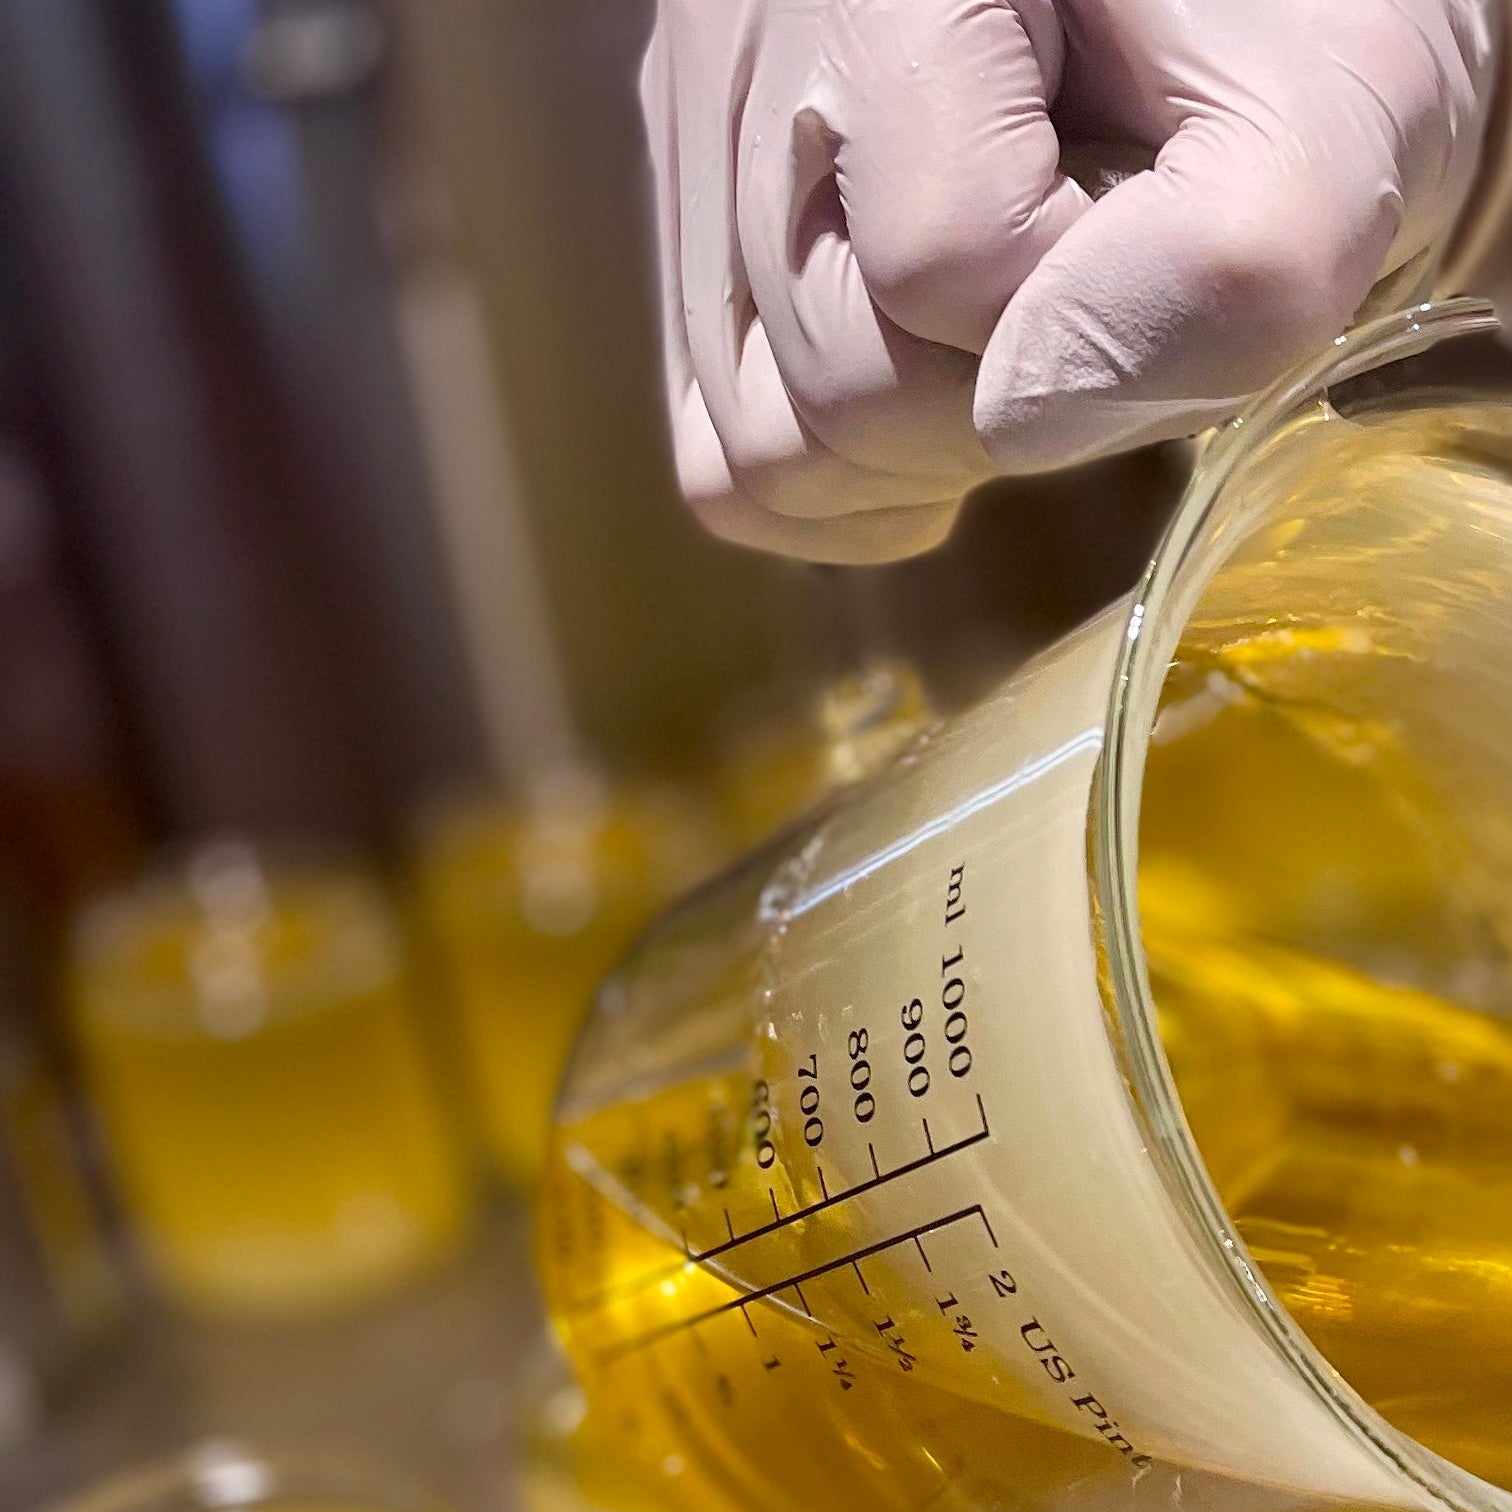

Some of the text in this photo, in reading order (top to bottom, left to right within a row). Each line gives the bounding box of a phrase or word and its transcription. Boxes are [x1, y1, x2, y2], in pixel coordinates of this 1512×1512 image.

[941, 862, 973, 1078] ml 1000
[848, 1027, 876, 1123] 800
[900, 998, 931, 1098] 900
[798, 1053, 824, 1147] 700
[989, 1269, 1018, 1298] 2
[1019, 1315, 1076, 1384] US
